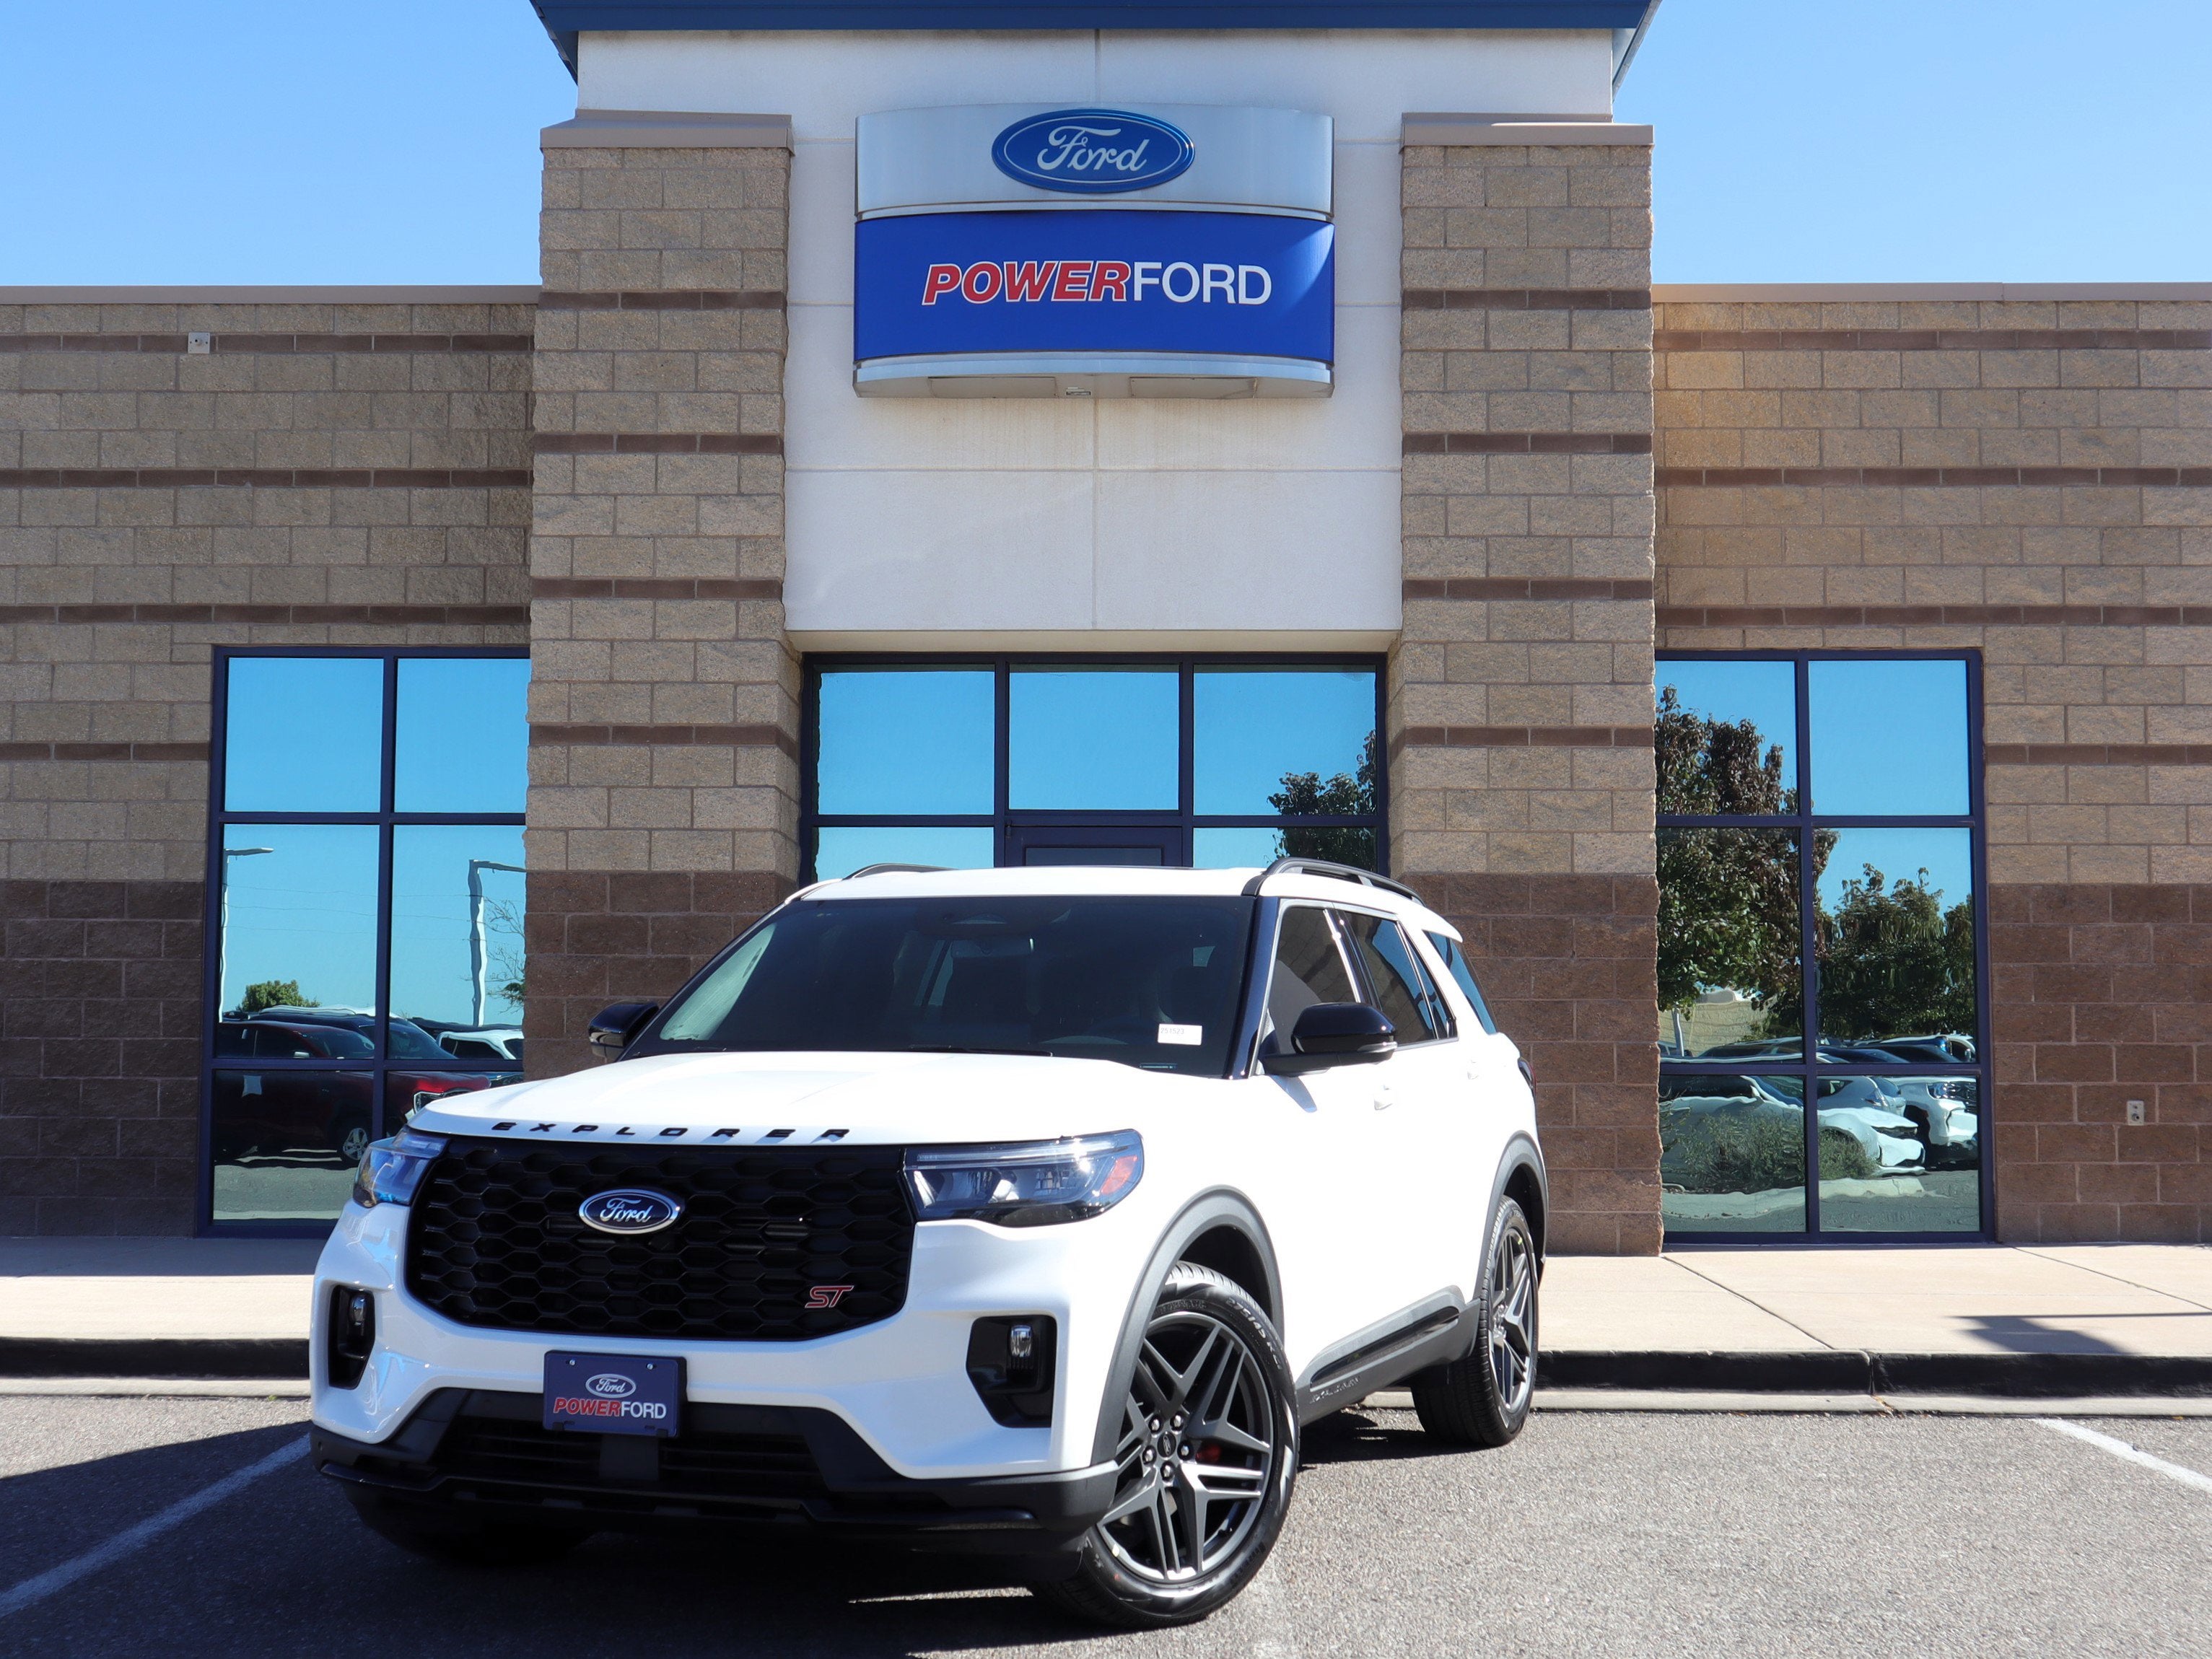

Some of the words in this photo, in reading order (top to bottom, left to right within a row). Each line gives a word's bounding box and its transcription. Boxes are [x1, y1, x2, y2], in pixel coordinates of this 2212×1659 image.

[1037, 126, 1149, 172] Ford
[491, 1122, 850, 1139] EXPLORER
[600, 1197, 651, 1222] Ford
[805, 1285, 854, 1309] ST
[595, 1378, 626, 1393] Ford
